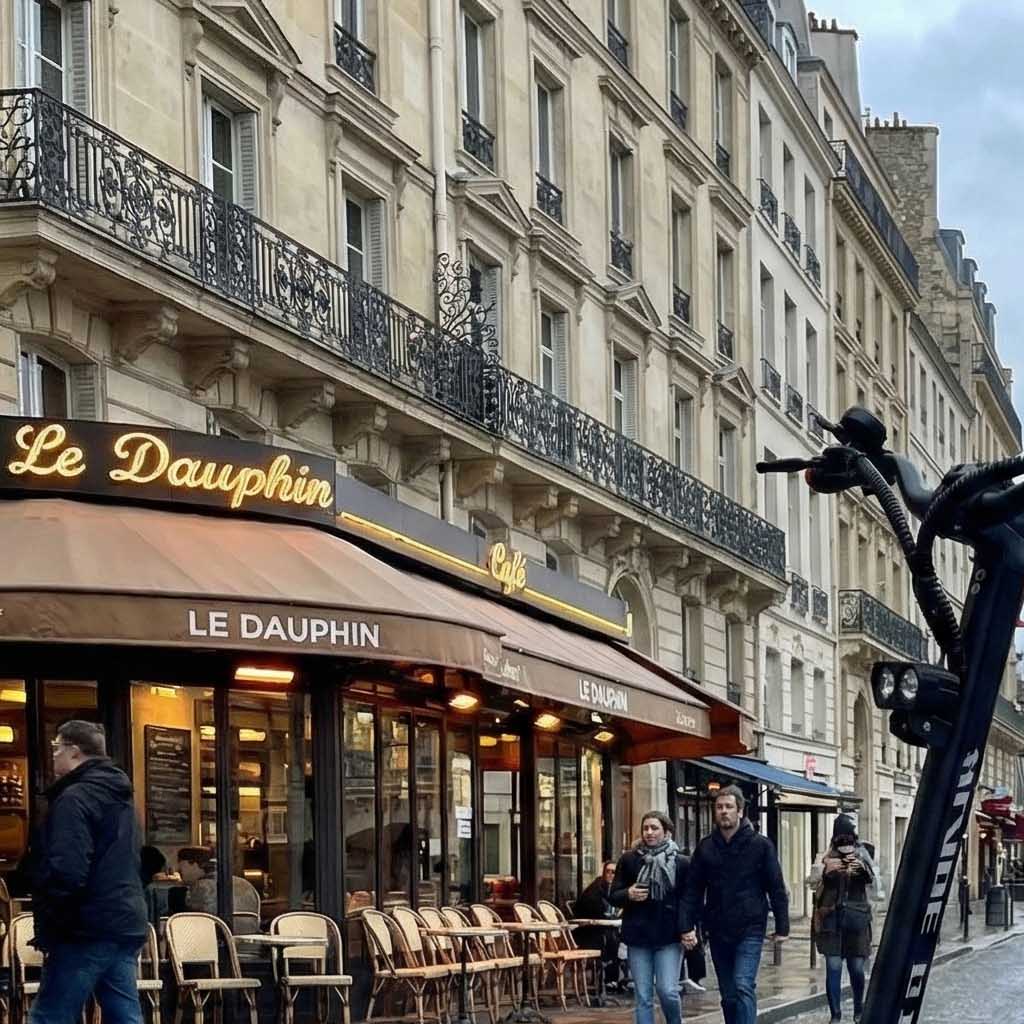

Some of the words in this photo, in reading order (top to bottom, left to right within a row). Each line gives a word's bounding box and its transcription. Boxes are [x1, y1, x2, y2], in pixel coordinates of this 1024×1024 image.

[8, 423, 86, 477] Le
[109, 432, 333, 509] Dauphin
[188, 610, 229, 638] LE
[239, 613, 380, 648] DAUPHIN
